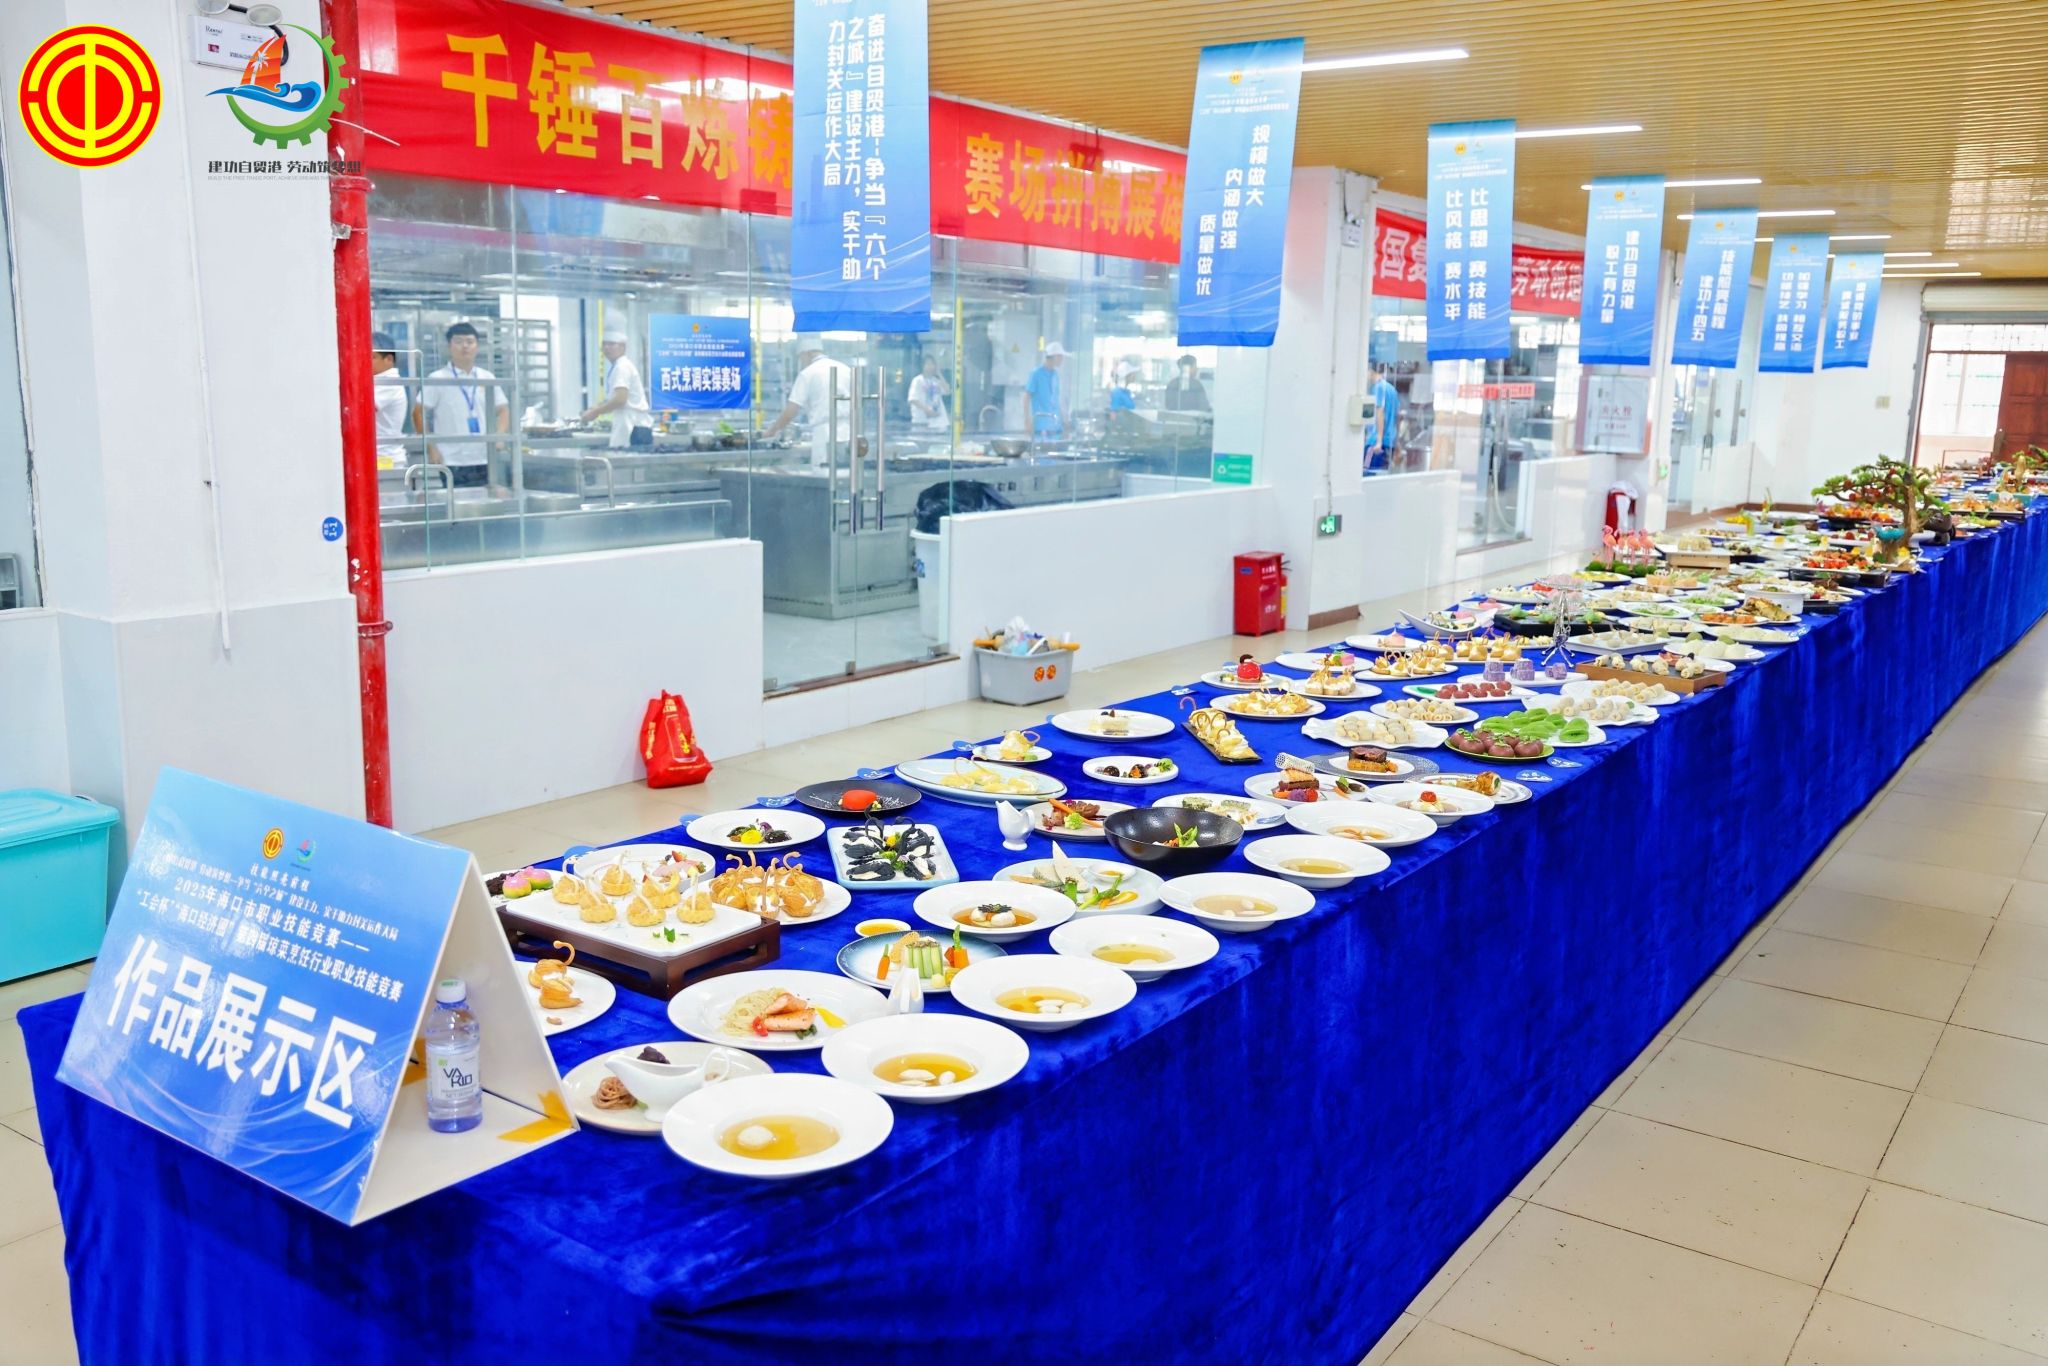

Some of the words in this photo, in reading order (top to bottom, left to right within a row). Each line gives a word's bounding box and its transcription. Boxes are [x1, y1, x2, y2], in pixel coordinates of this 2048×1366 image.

[824, 19, 846, 187] 力封关运作大局
[1245, 124, 1271, 206] 规模做大
[1219, 168, 1244, 250] 内涵做强
[1444, 190, 1463, 250] 比风格
[1195, 214, 1217, 296] 质量做优
[1444, 262, 1462, 321] 赛水平
[1467, 260, 1487, 320] 赛技能
[660, 366, 741, 393] 西式烹调实操赛场
[107, 934, 377, 1129] 作品展示区
